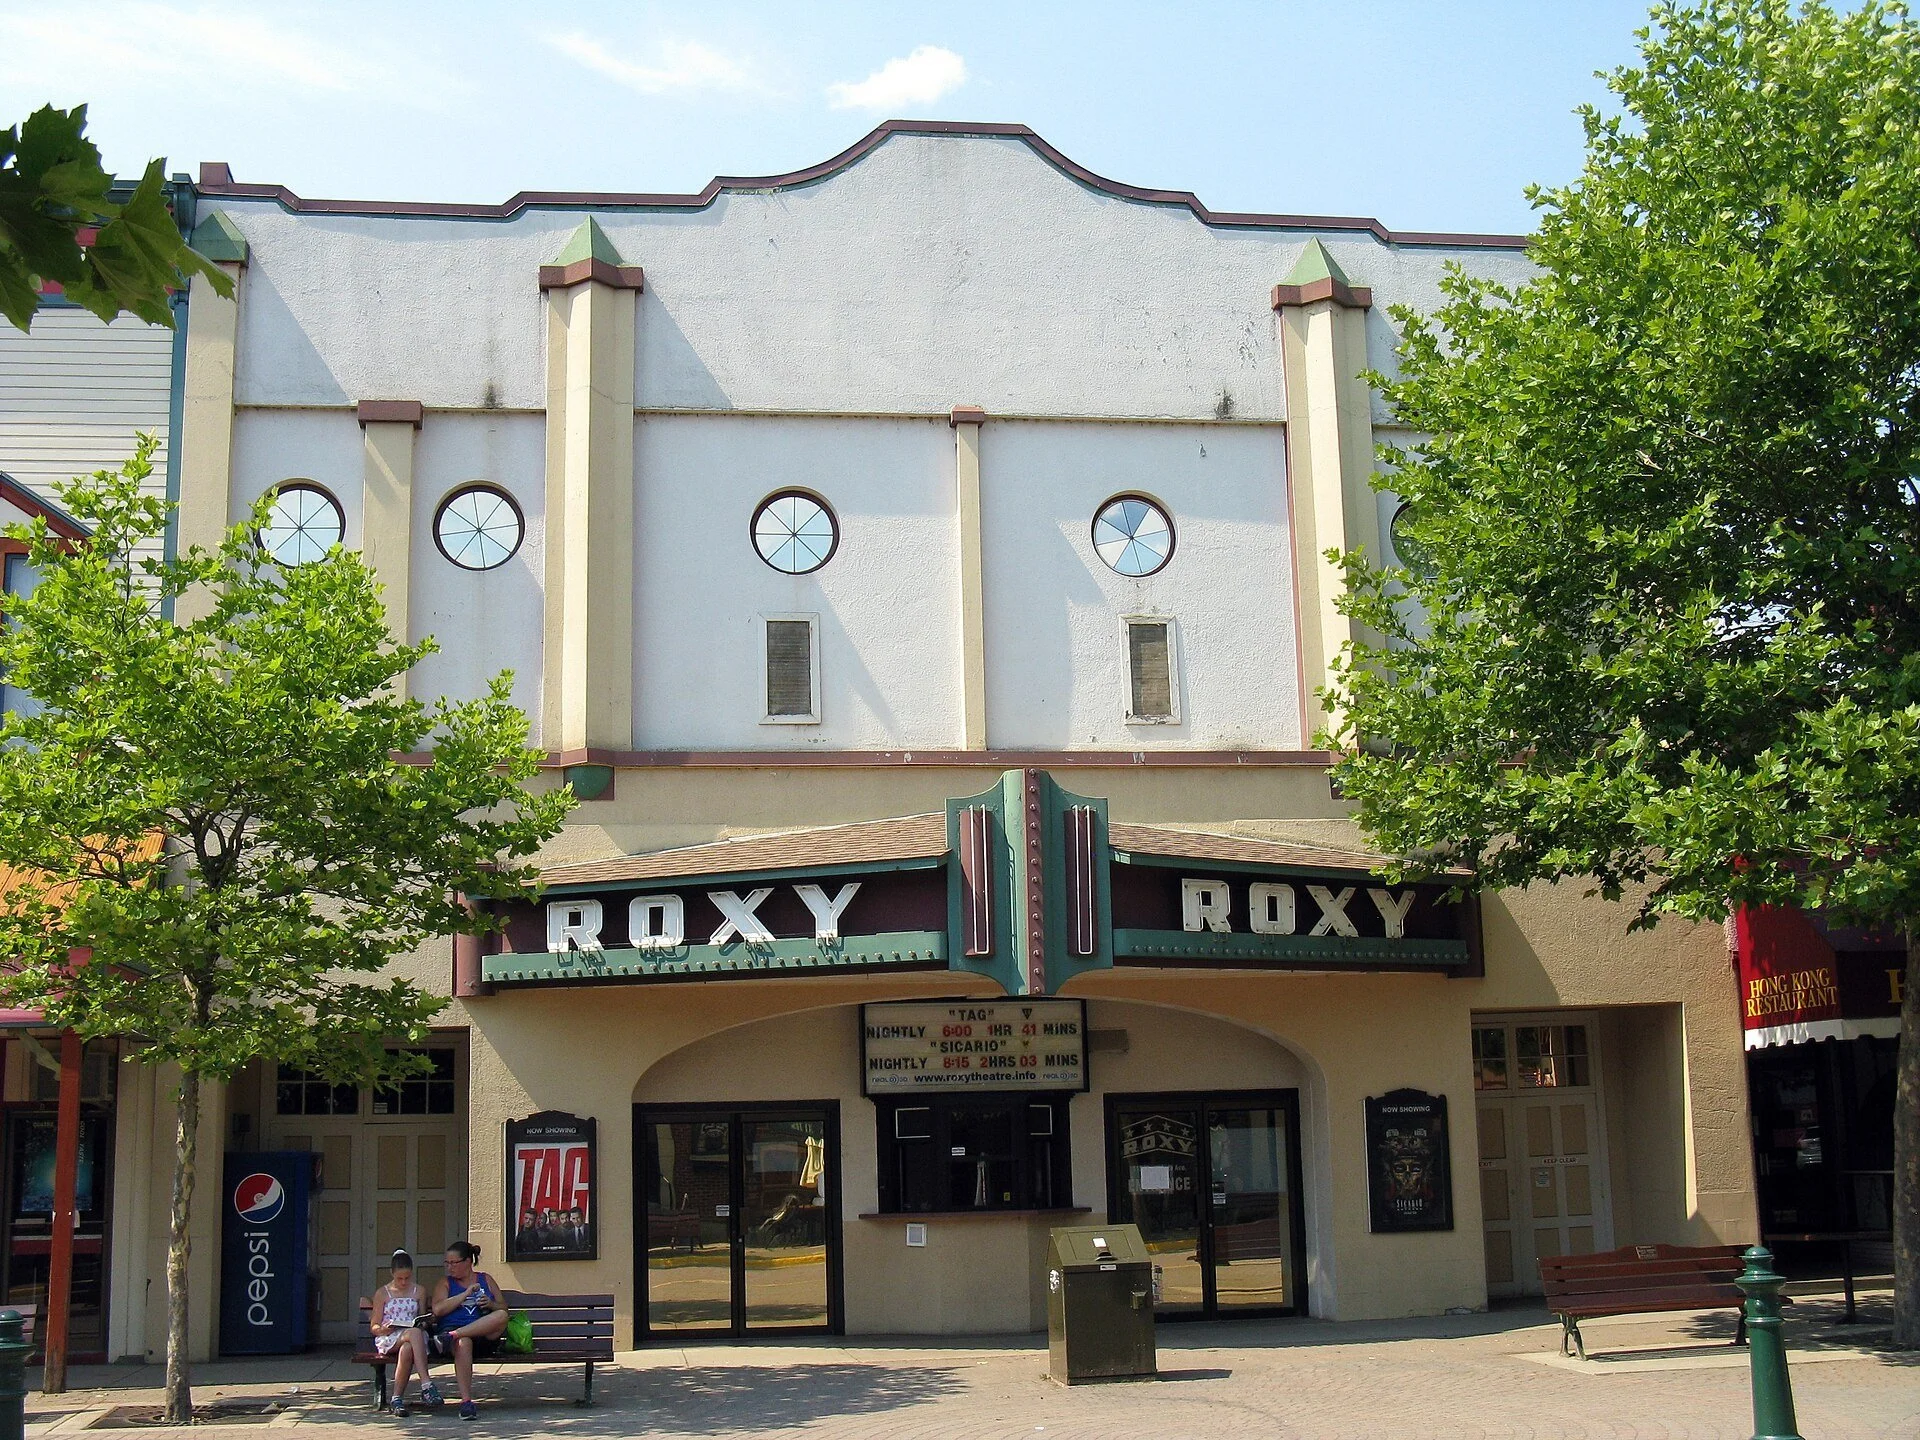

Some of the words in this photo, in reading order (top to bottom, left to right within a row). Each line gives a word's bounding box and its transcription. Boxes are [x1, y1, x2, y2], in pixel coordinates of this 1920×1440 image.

[546, 882, 863, 954] ROXY
[1181, 878, 1416, 939] ROXY
[1749, 974, 1788, 999] HONG
[1791, 967, 1831, 991] KONG
[1746, 985, 1838, 1018] RESTAURANT
[866, 1026, 925, 1039] NIGHTLY
[942, 1025, 972, 1037] 6:00
[1022, 1024, 1036, 1036] 41
[869, 1057, 928, 1070] NIGHTLY
[942, 1056, 970, 1069] 8:15
[980, 1056, 1016, 1069] 2HRS
[1020, 1055, 1037, 1067] 03
[1045, 1054, 1078, 1067] MINS
[914, 1070, 1036, 1084] www.roxytheatre.info
[1382, 1106, 1398, 1114] NOW
[1400, 1105, 1431, 1113] SHOWING
[526, 1127, 543, 1135] NOW
[1123, 1134, 1192, 1156] ROXY
[518, 1148, 589, 1233] TAG
[243, 1231, 275, 1326] pepsi
